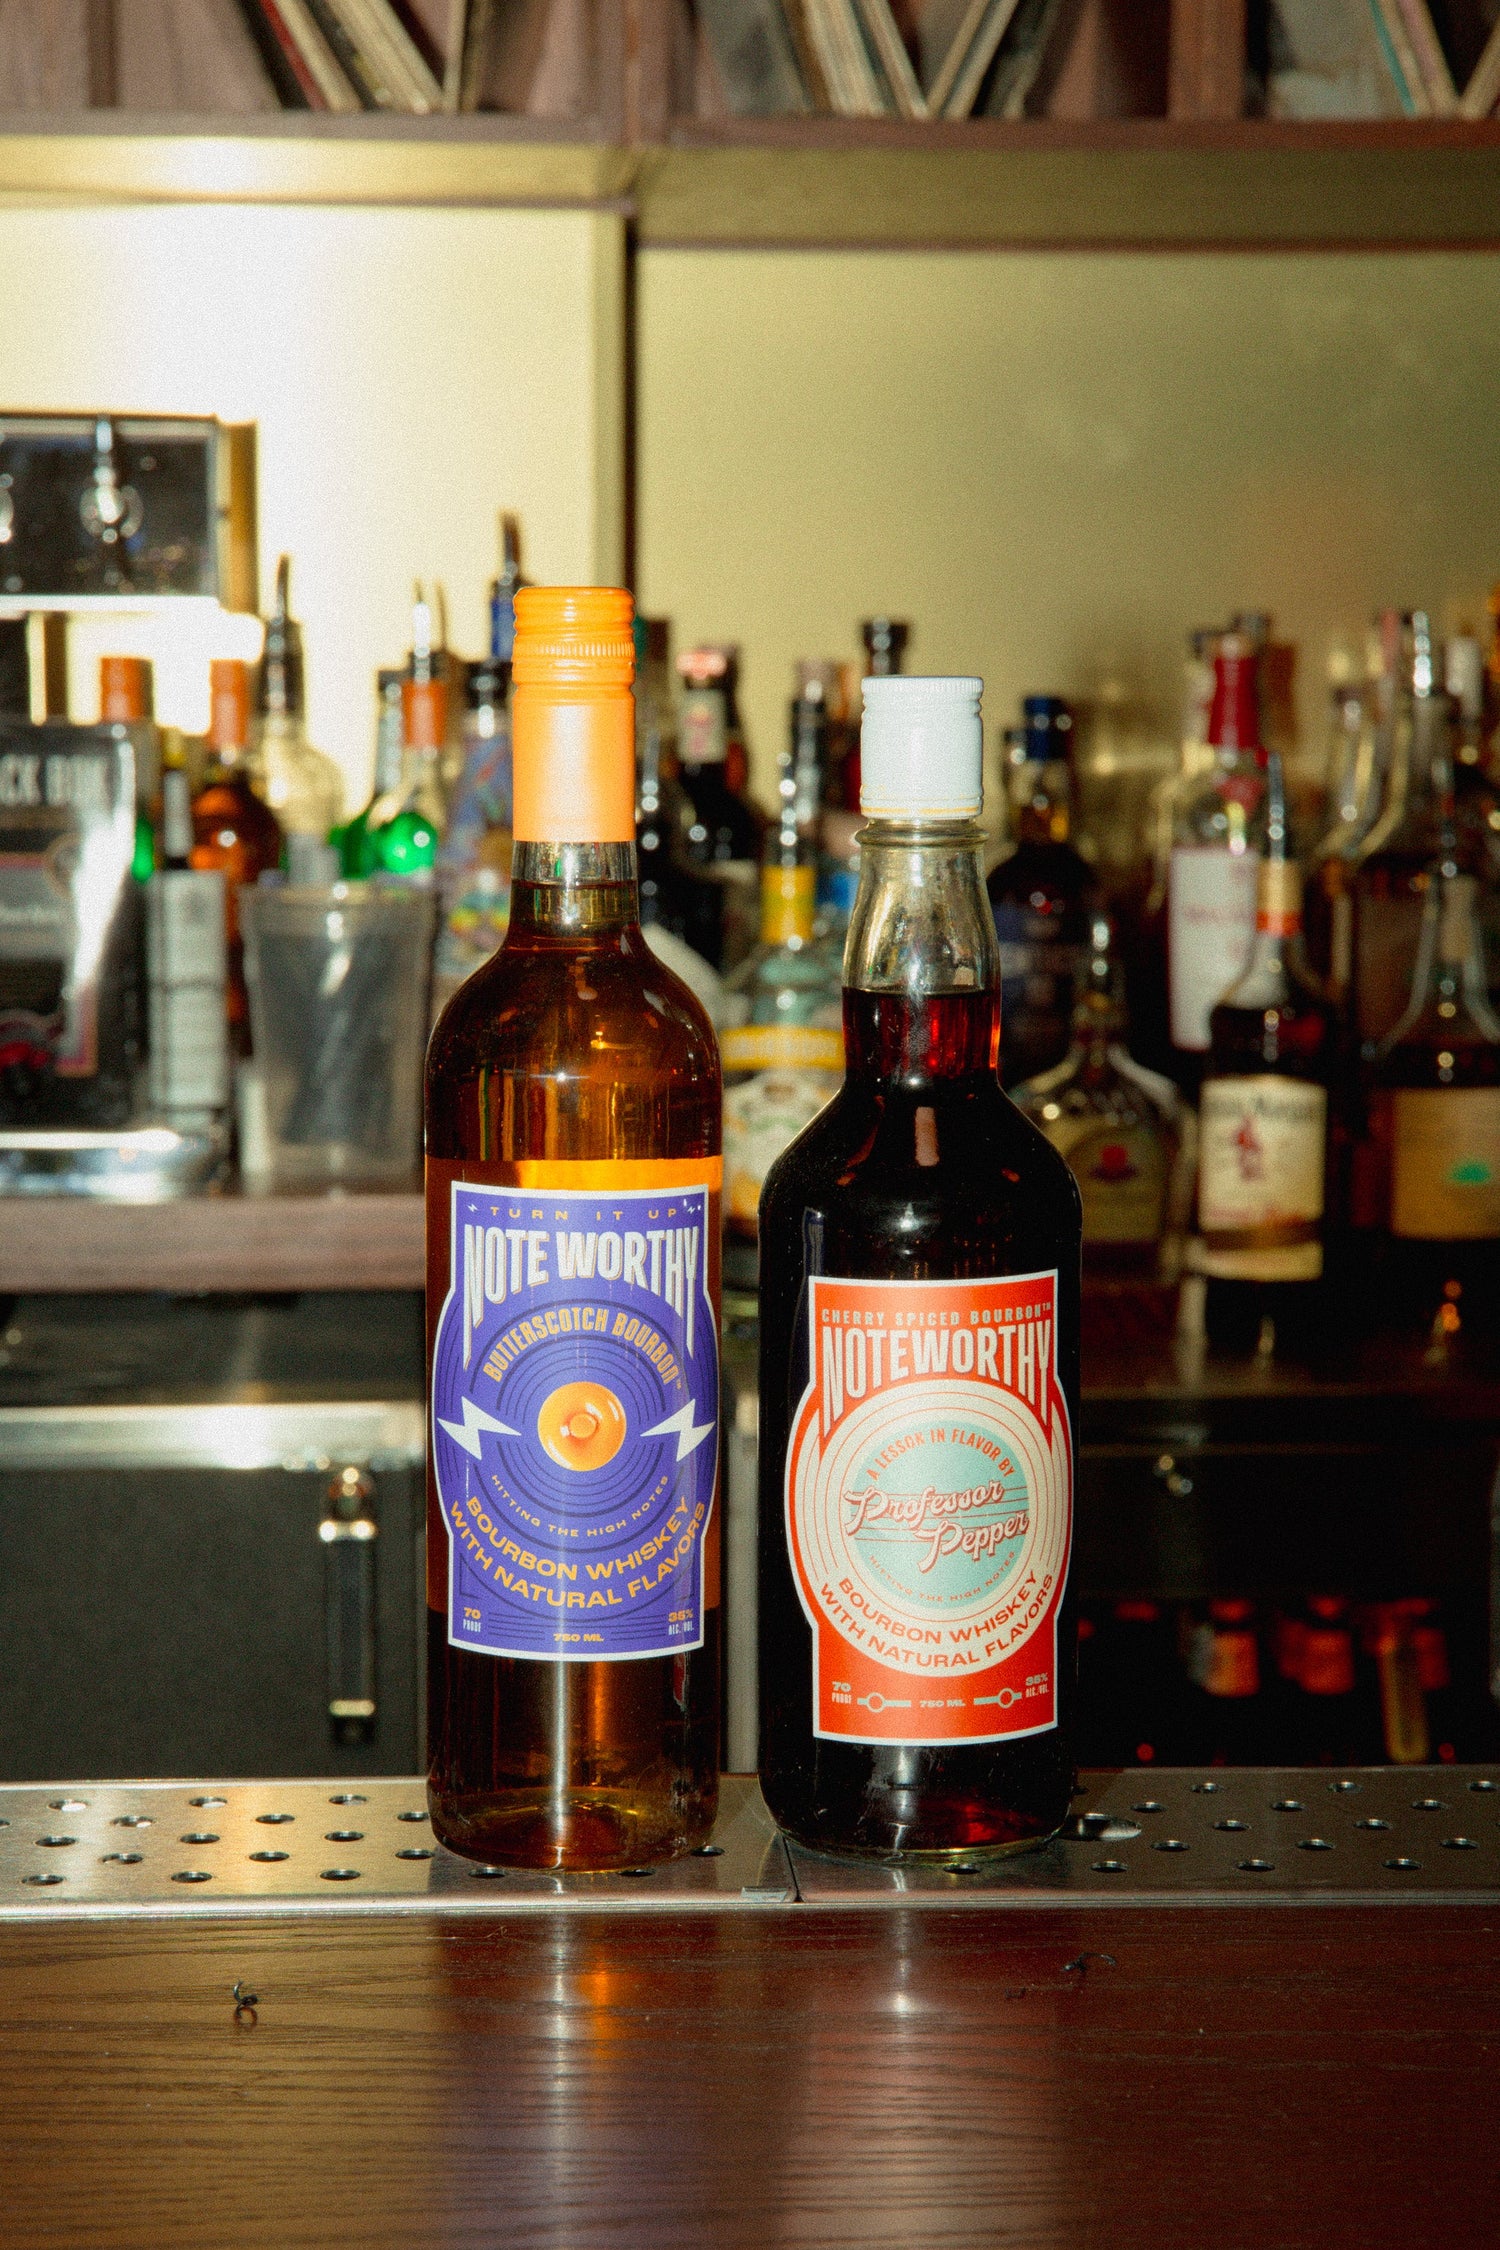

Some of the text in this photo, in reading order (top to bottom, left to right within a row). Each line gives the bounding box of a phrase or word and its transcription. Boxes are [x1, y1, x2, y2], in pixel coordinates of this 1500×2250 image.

[490, 1206, 677, 1221] TURN IT UP
[482, 1306, 607, 1383] BUTTERSCOTCH
[822, 1308, 885, 1327] CHERRY
[895, 1311, 960, 1327] SPICED
[866, 1427, 1016, 1482] A LESSON IN FLAVOR BY
[490, 1473, 670, 1538] HITTING THE HIGH NOTES
[843, 1478, 1005, 1537] Professor
[450, 1500, 706, 1609] WITH NATURAL FLAVORS
[466, 1496, 690, 1581] BOURBON WHISKEY
[913, 1508, 1031, 1575] Pepper
[918, 1591, 943, 1602] THE
[950, 1586, 982, 1601] HIGH
[984, 1550, 1016, 1588] NOTES
[463, 1606, 481, 1620] 70
[668, 1607, 694, 1623] 35%
[819, 1572, 1054, 1669] WITH NATURAL FLAVORS
[838, 1569, 1038, 1645] BOURBON WHISKEY
[553, 1633, 605, 1643] 750 ML
[832, 1681, 851, 1693] 70
[919, 1699, 945, 1708] 750
